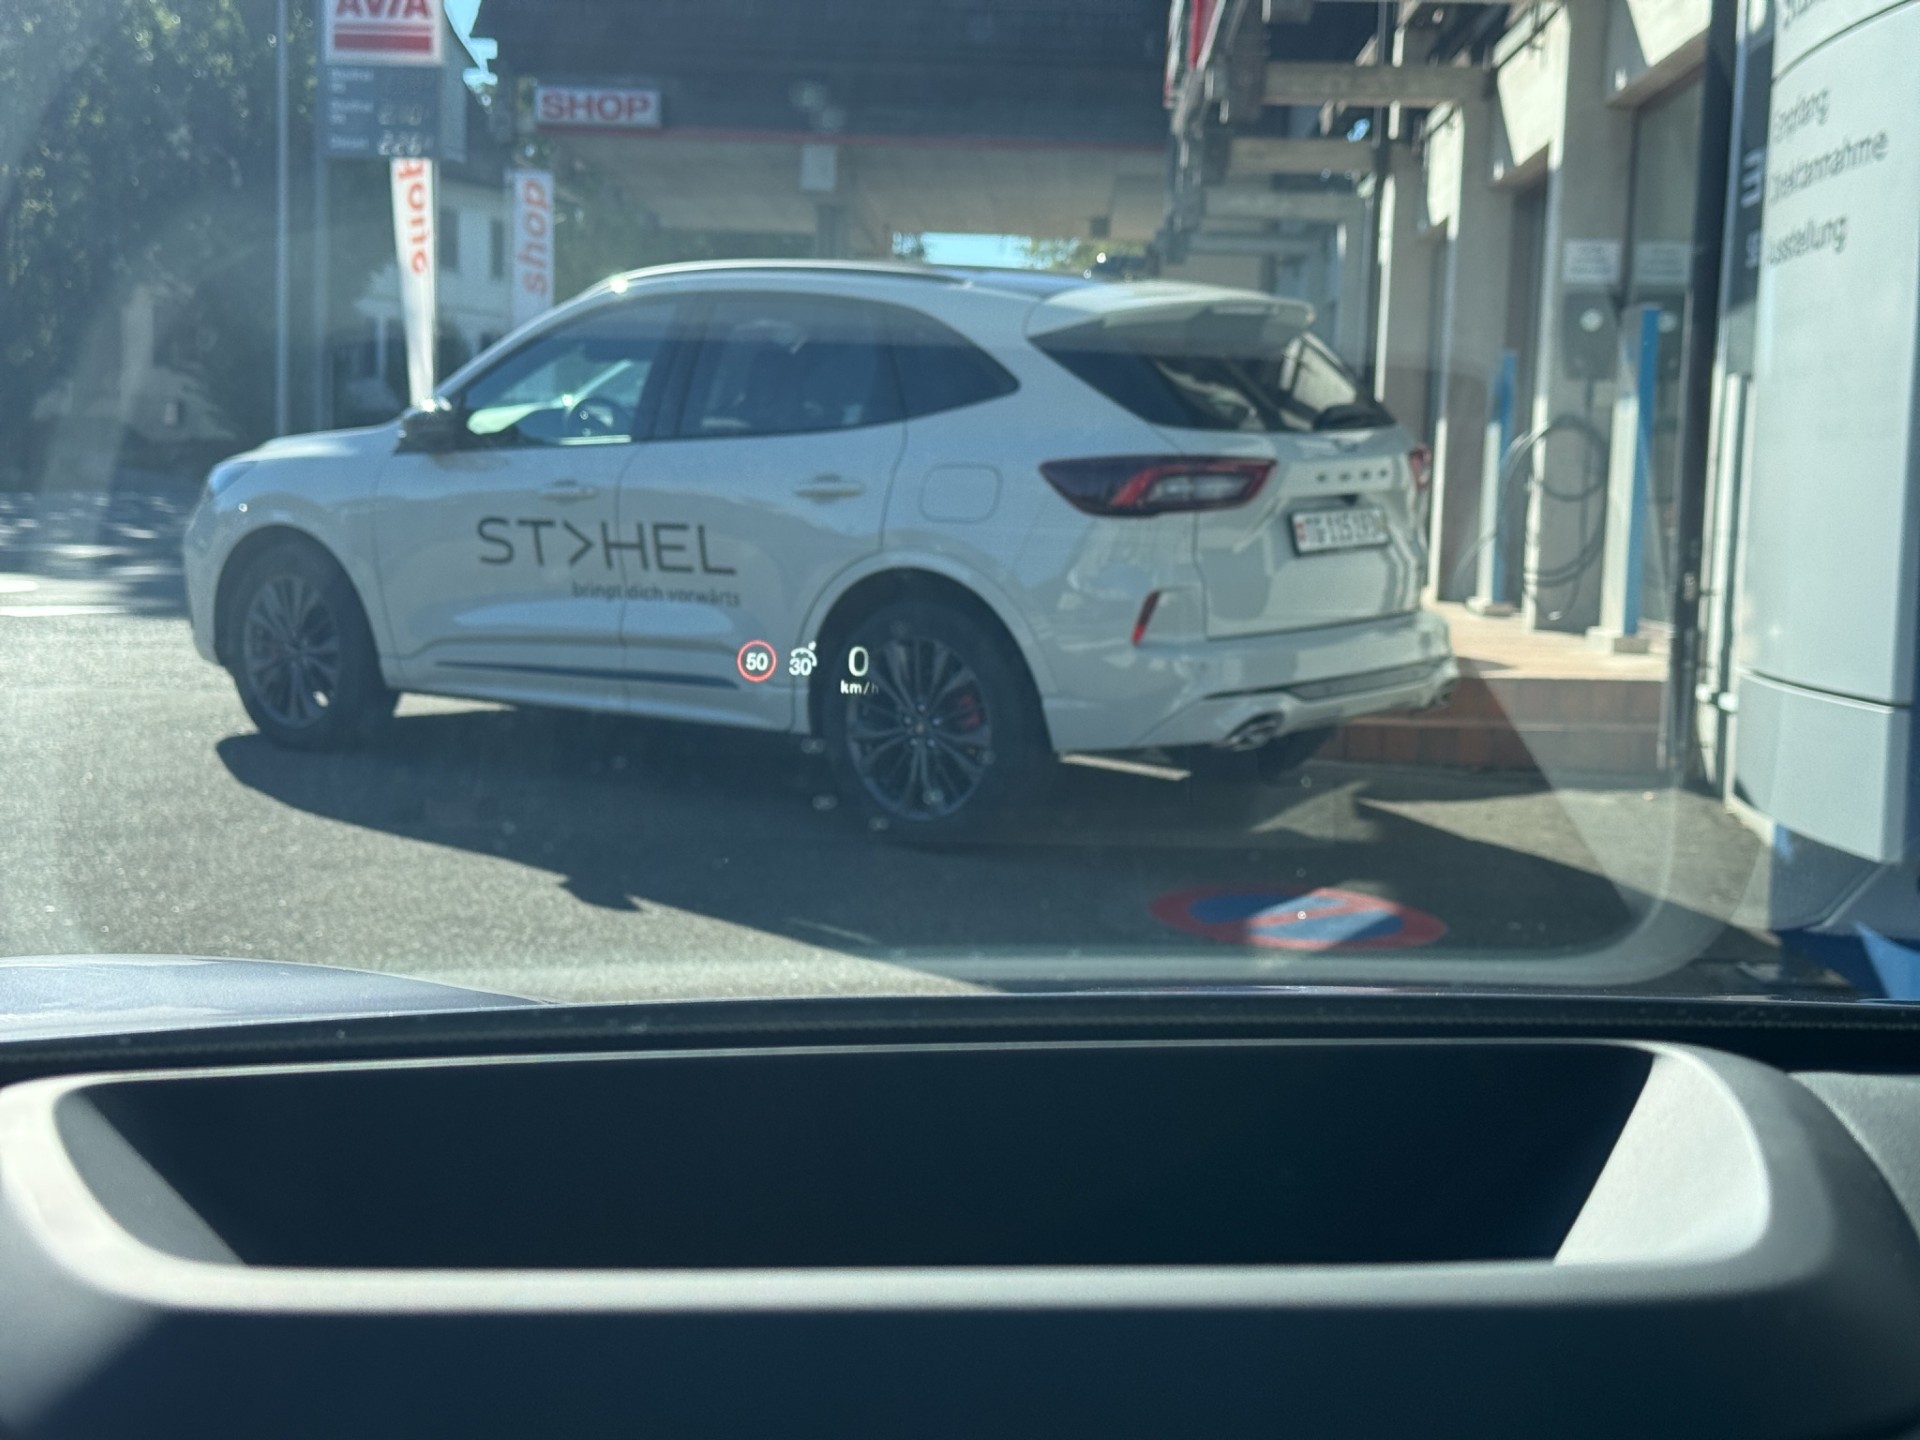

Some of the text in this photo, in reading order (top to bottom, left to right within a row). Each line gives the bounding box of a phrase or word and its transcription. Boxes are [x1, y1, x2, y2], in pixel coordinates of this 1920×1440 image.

[335, 0, 430, 18] AVIA
[541, 93, 652, 121] SHOP
[518, 179, 550, 292] shop
[571, 580, 741, 608] bringt dich vorwärts
[746, 652, 769, 671] 50
[788, 657, 813, 676] 30
[848, 646, 869, 677] 0
[840, 679, 879, 695] km/h
